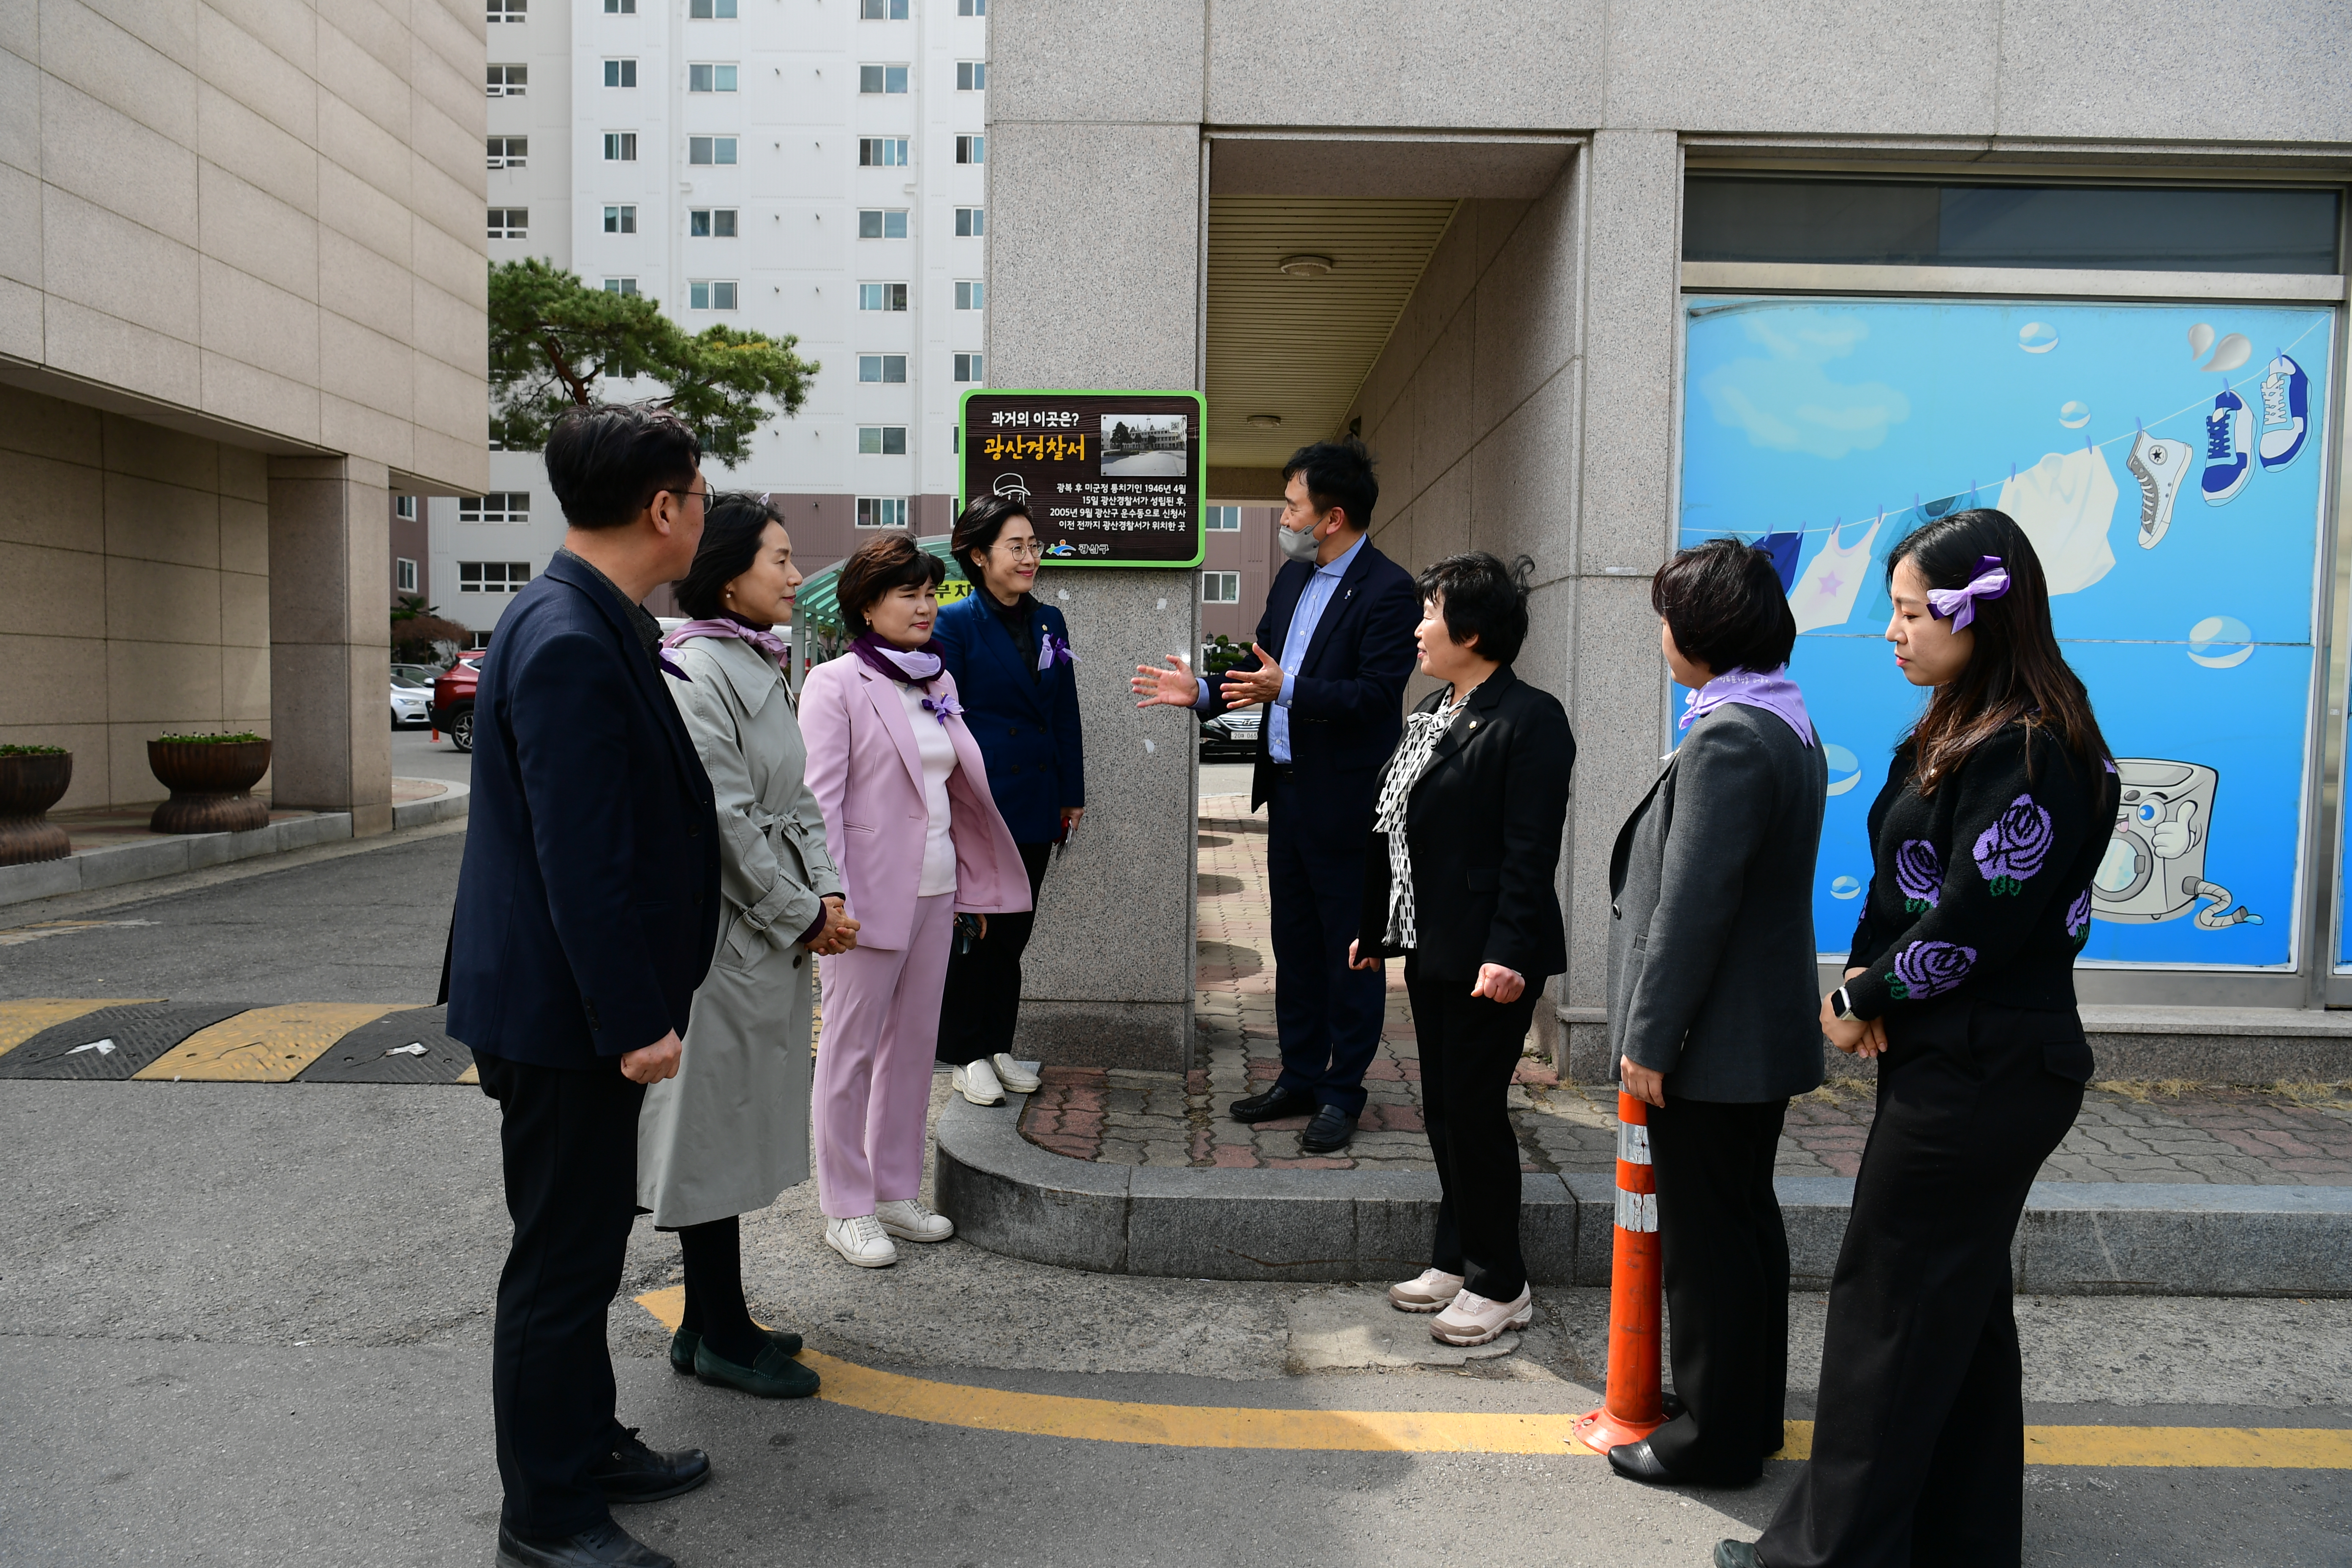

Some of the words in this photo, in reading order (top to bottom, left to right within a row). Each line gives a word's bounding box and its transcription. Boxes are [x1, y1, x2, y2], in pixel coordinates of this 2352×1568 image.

[991, 411, 1029, 427] 과거의
[1033, 411, 1079, 427] 이곳은?
[984, 434, 1084, 460] 광산경찰서
[1056, 483, 1073, 493] 광복
[1075, 483, 1083, 493] 후
[1085, 483, 1108, 493] 미군정
[1111, 483, 1142, 494] 통치기인
[1145, 484, 1171, 494] 1946년
[1173, 484, 1186, 494] 4월
[1082, 495, 1098, 506] 15일
[1100, 496, 1149, 506] 광산경찰서가
[1150, 496, 1174, 506] 성립된
[1176, 496, 1186, 507] 후,
[1050, 508, 1078, 517] 2005년
[1080, 508, 1092, 518] 9월
[1094, 508, 1119, 518] 광산구
[1120, 508, 1160, 519] 운수동으로
[1162, 509, 1186, 519] 신청사
[1059, 520, 1075, 530] 이전
[1077, 520, 1100, 530] 전까지
[1102, 520, 1150, 531] 광산경찰서가
[1152, 521, 1176, 531] 위치한
[1177, 521, 1186, 531] 곳
[1078, 544, 1109, 555] 광산구
